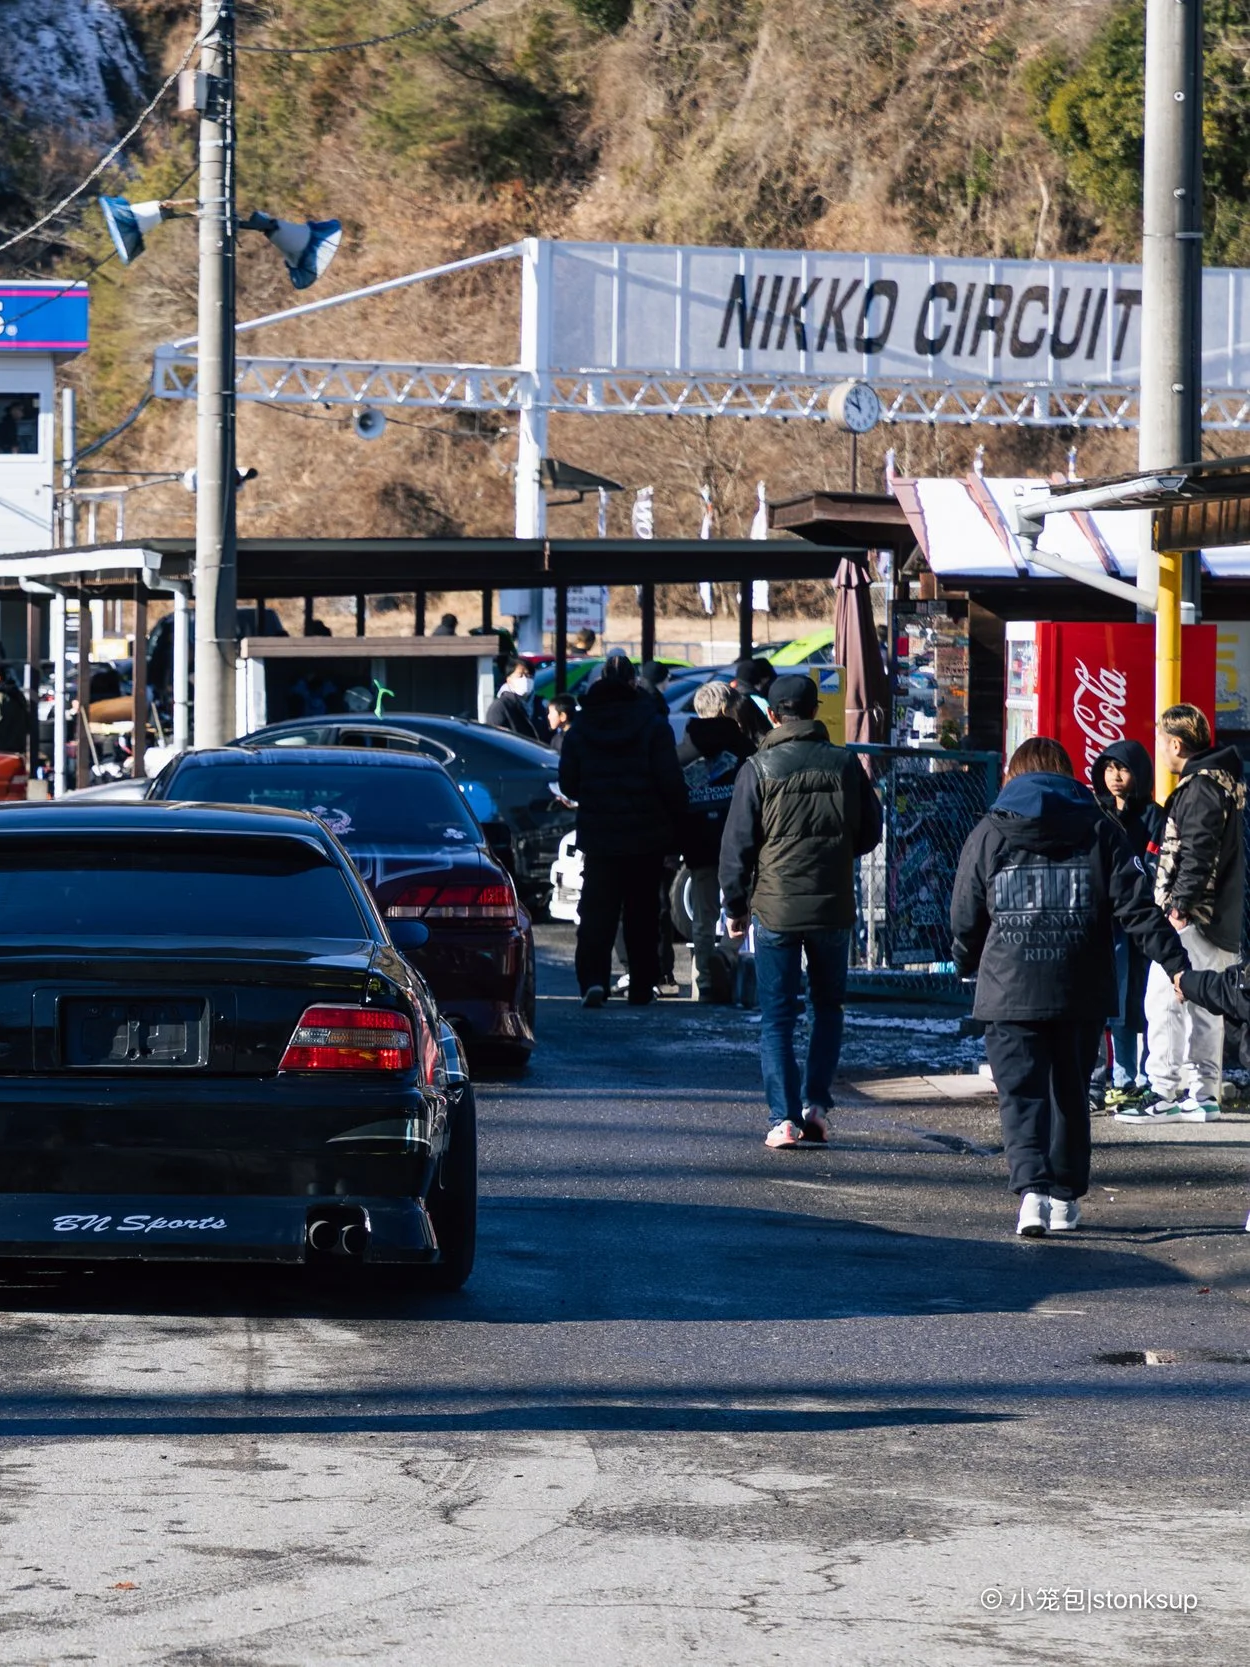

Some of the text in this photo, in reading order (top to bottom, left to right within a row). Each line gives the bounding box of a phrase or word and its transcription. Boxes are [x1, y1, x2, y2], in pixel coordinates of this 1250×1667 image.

[717, 273, 1142, 362] NIKKO CIRCUIT
[998, 914, 1034, 928] FOR
[1024, 947, 1068, 961] RIDE
[52, 1214, 228, 1233] BN Sports
